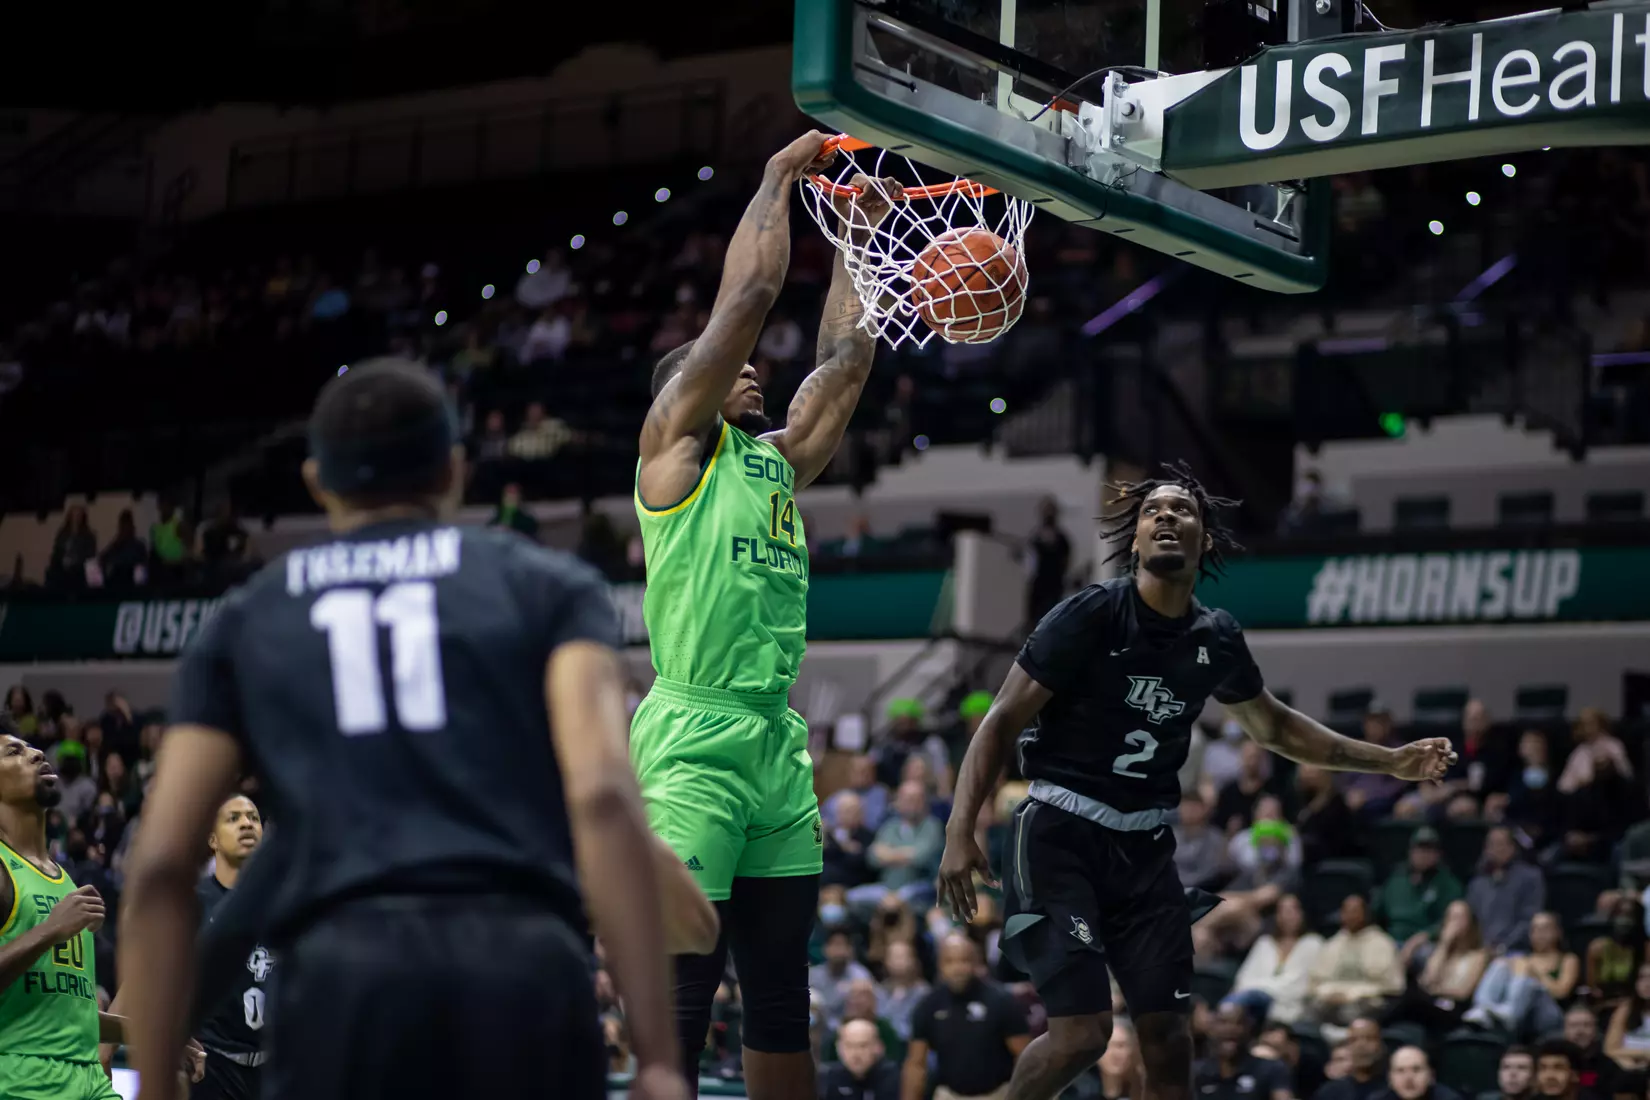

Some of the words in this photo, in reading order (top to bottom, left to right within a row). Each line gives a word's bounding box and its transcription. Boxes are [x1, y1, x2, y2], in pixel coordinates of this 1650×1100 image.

[743, 454, 796, 490] SOU
[769, 490, 797, 548] 14
[731, 535, 808, 582] FLORD
[1307, 550, 1581, 624] #HORNSUP
[310, 580, 447, 735] 11
[1197, 646, 1210, 664] A
[1124, 675, 1186, 724] UCF
[1112, 729, 1159, 779] 2
[24, 971, 96, 1000] FLORID
[246, 943, 275, 982] CF
[243, 987, 266, 1031] 0
